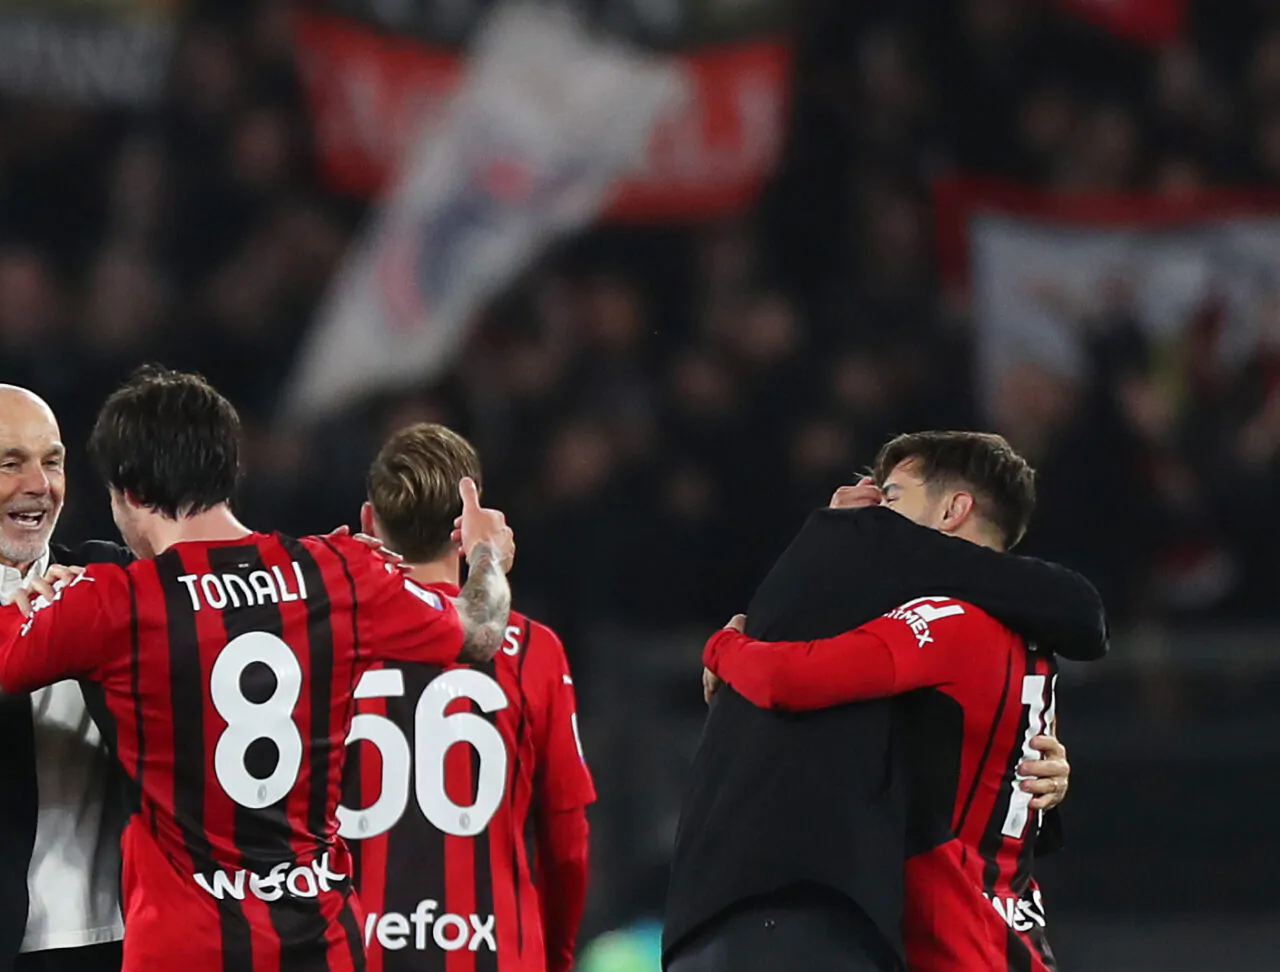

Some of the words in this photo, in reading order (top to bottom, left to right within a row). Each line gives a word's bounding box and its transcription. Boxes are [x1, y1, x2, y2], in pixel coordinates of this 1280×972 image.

[178, 563, 308, 612] TONALI
[211, 631, 302, 808] 8
[335, 669, 508, 840] 56
